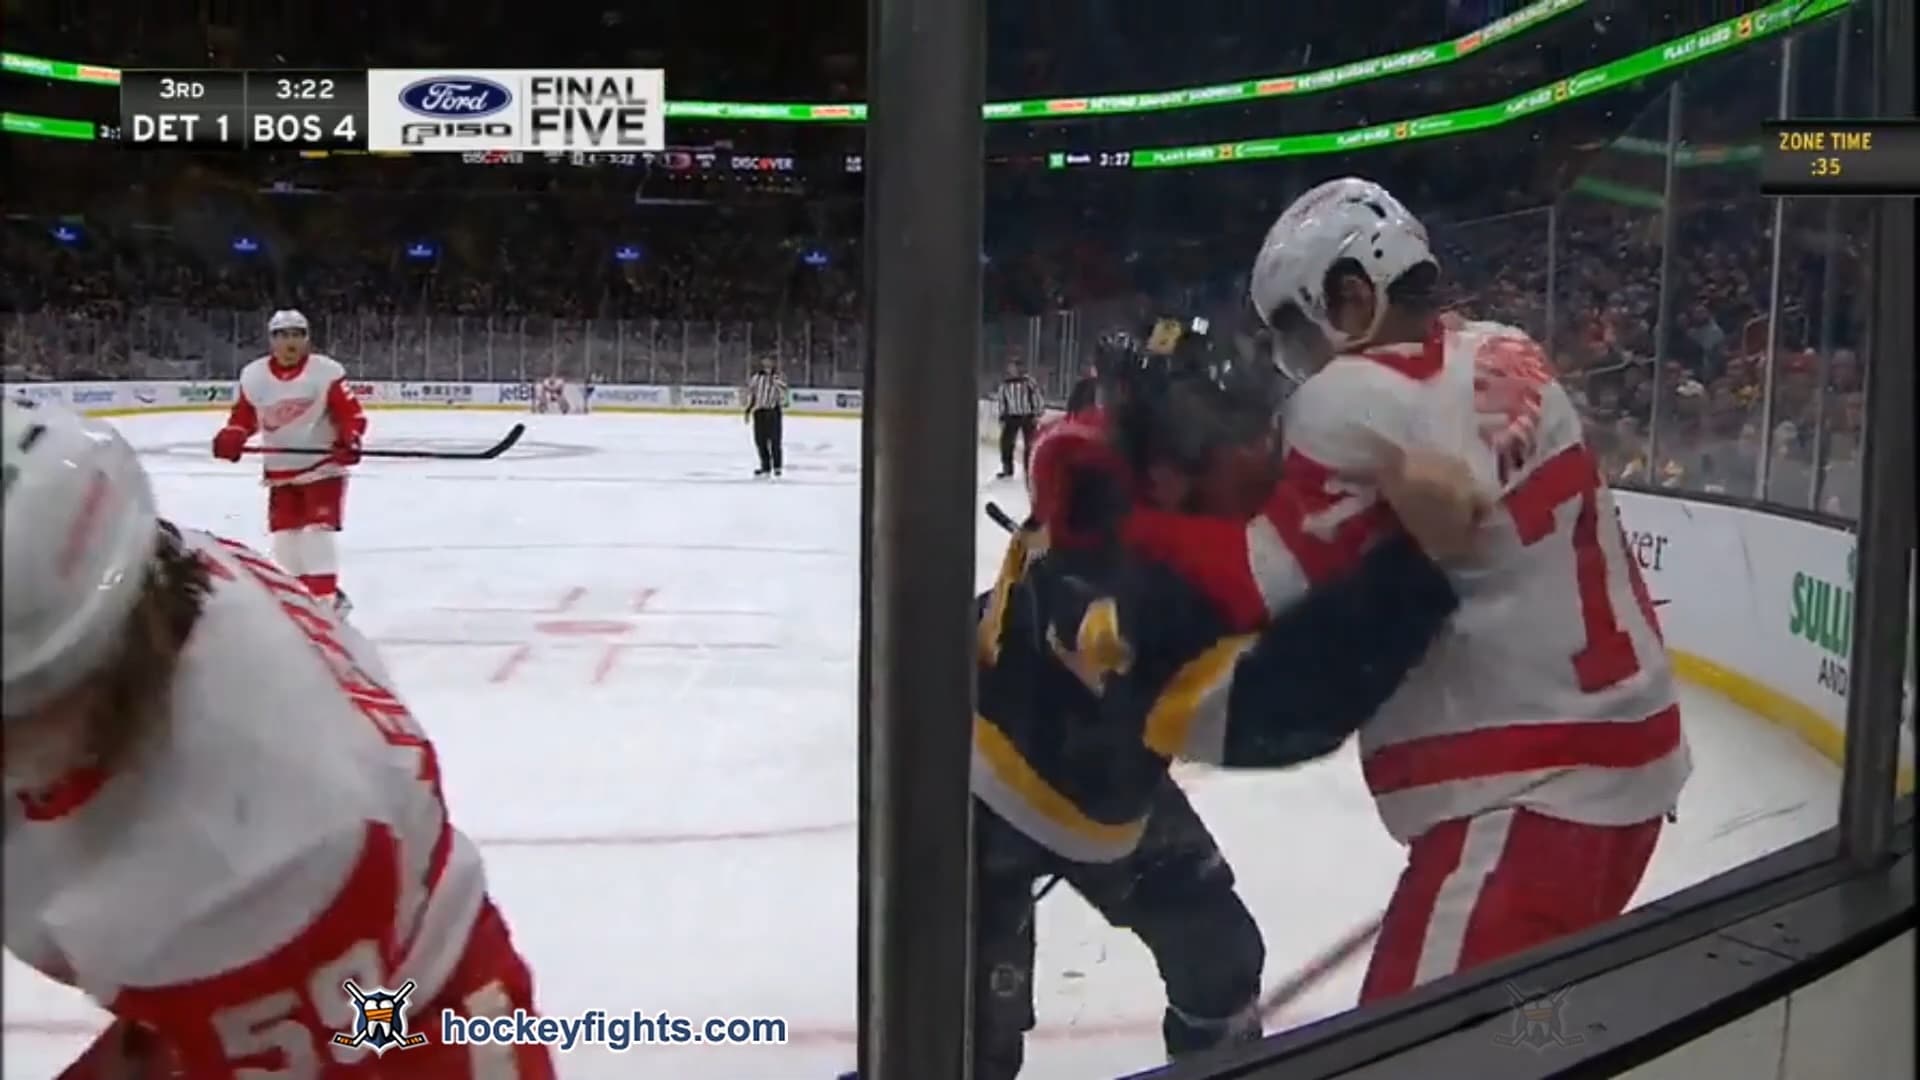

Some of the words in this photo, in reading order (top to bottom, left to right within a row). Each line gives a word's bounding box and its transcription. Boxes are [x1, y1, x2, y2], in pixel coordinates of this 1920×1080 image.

[731, 156, 794, 170] DISCOVER
[1099, 151, 1130, 167] 3:27
[1500, 440, 1665, 694] 7
